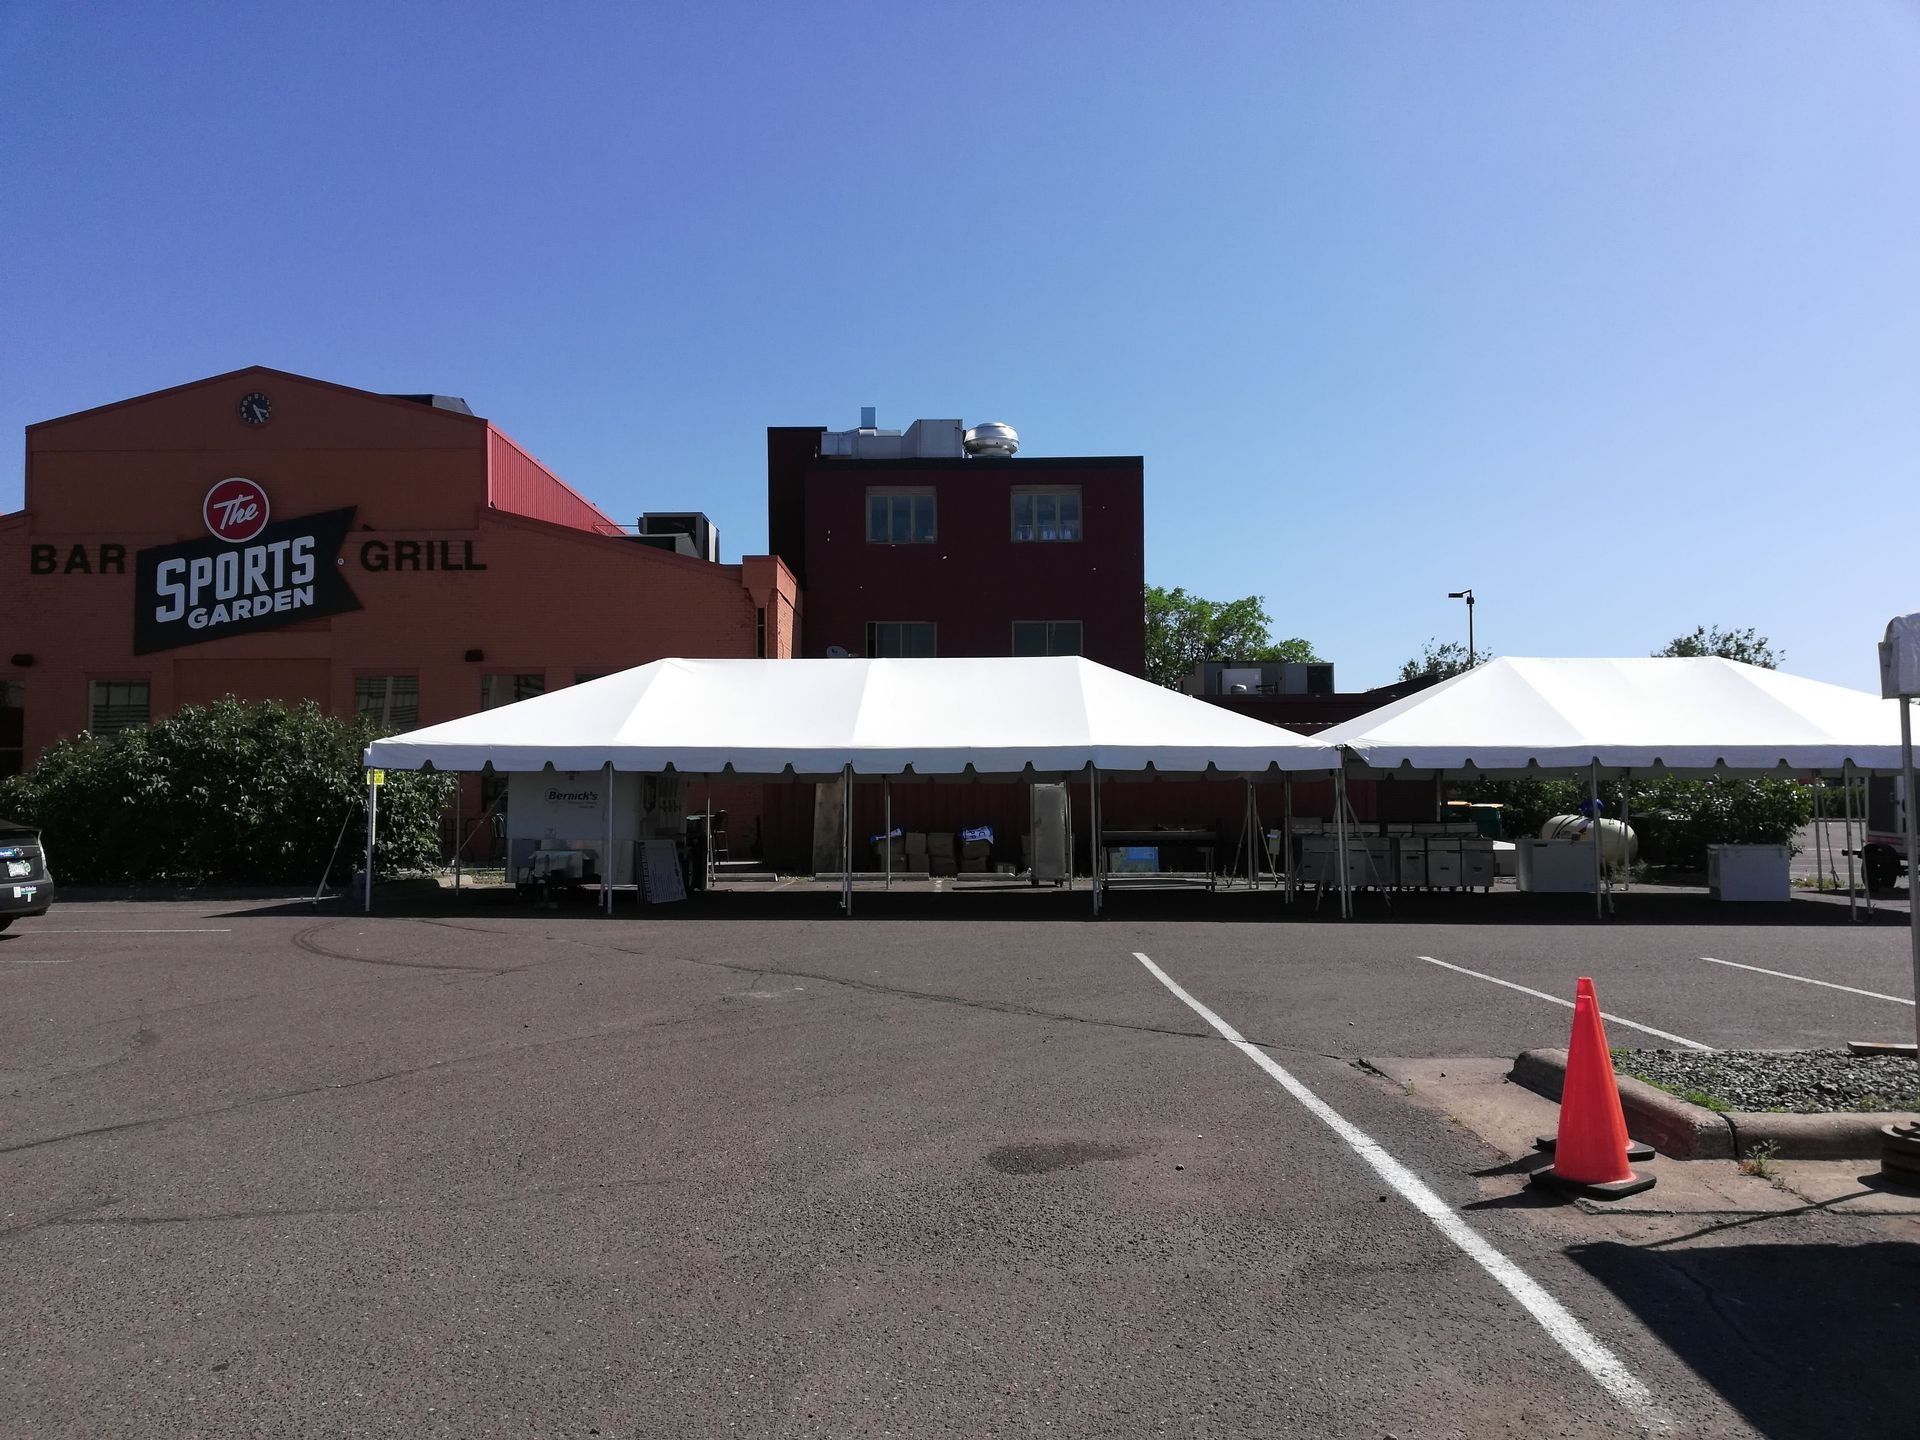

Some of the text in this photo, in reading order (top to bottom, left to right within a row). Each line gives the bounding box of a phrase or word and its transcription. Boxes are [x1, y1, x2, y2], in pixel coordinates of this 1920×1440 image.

[213, 494, 259, 531] The
[31, 543, 126, 575] BAR
[360, 540, 487, 572] GRILL
[155, 535, 316, 623] SPORTS
[187, 584, 314, 629] GARDEN
[548, 791, 599, 801] Bernick's
